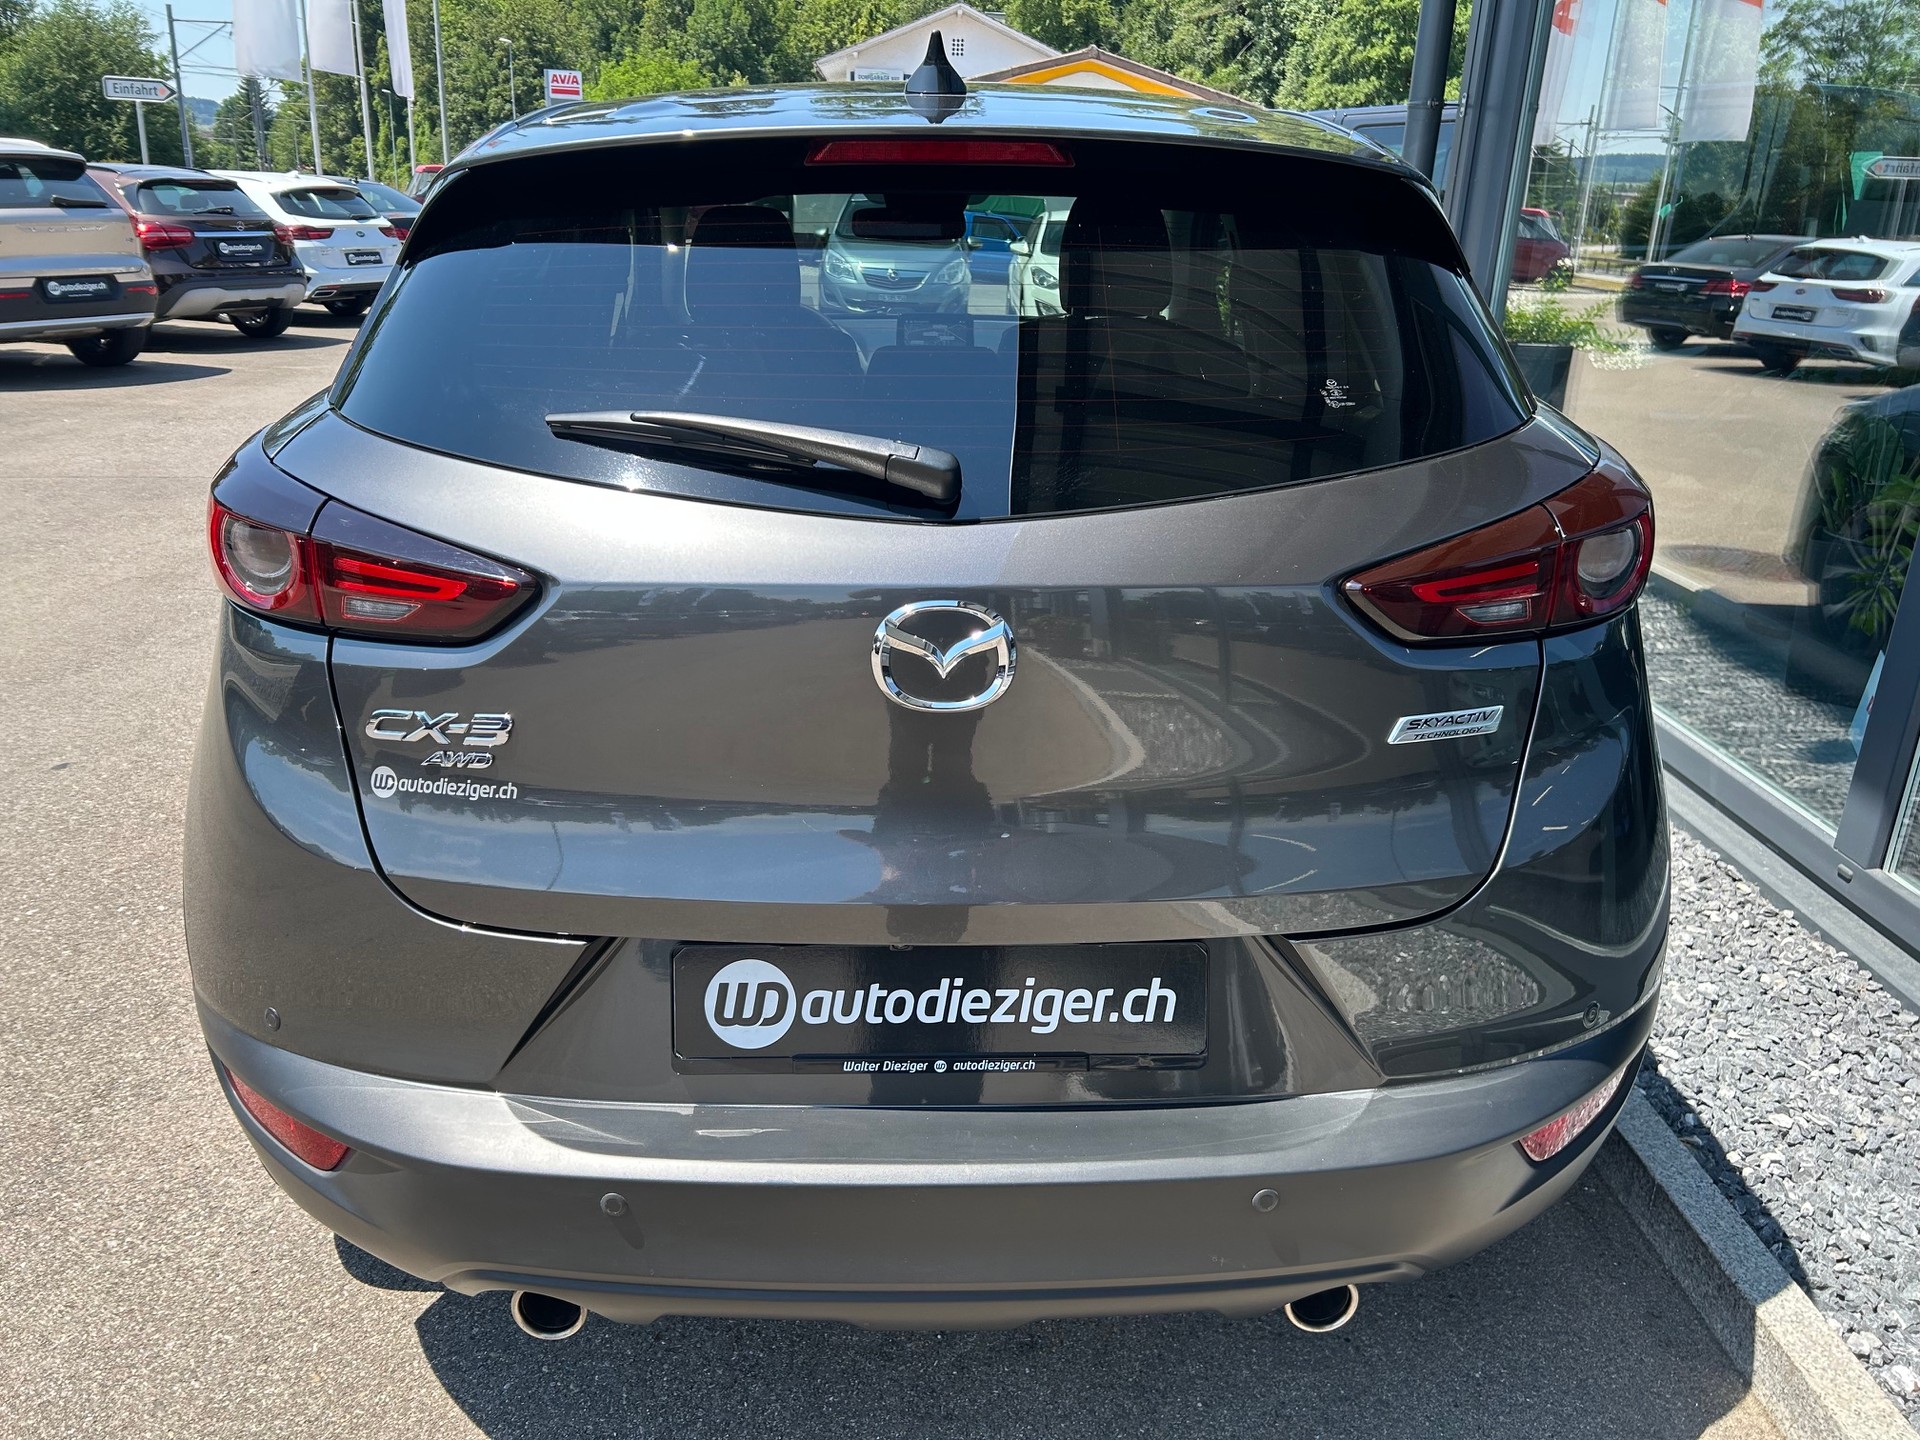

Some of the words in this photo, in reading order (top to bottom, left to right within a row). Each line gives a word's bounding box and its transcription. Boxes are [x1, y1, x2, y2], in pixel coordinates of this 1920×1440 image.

[113, 83, 158, 96] Einfahrt
[365, 709, 513, 747] CX-3
[1407, 710, 1495, 730] SKYACTIV
[1413, 726, 1483, 740] TECHNOLOGY
[421, 751, 494, 769] AWD
[399, 778, 518, 800] autodieziger.ch
[801, 977, 1177, 1033] autodieziger.ch
[843, 1061, 880, 1071] Walter
[883, 1061, 928, 1072] Dieziger
[953, 1060, 1036, 1072] autodieziger.ch
